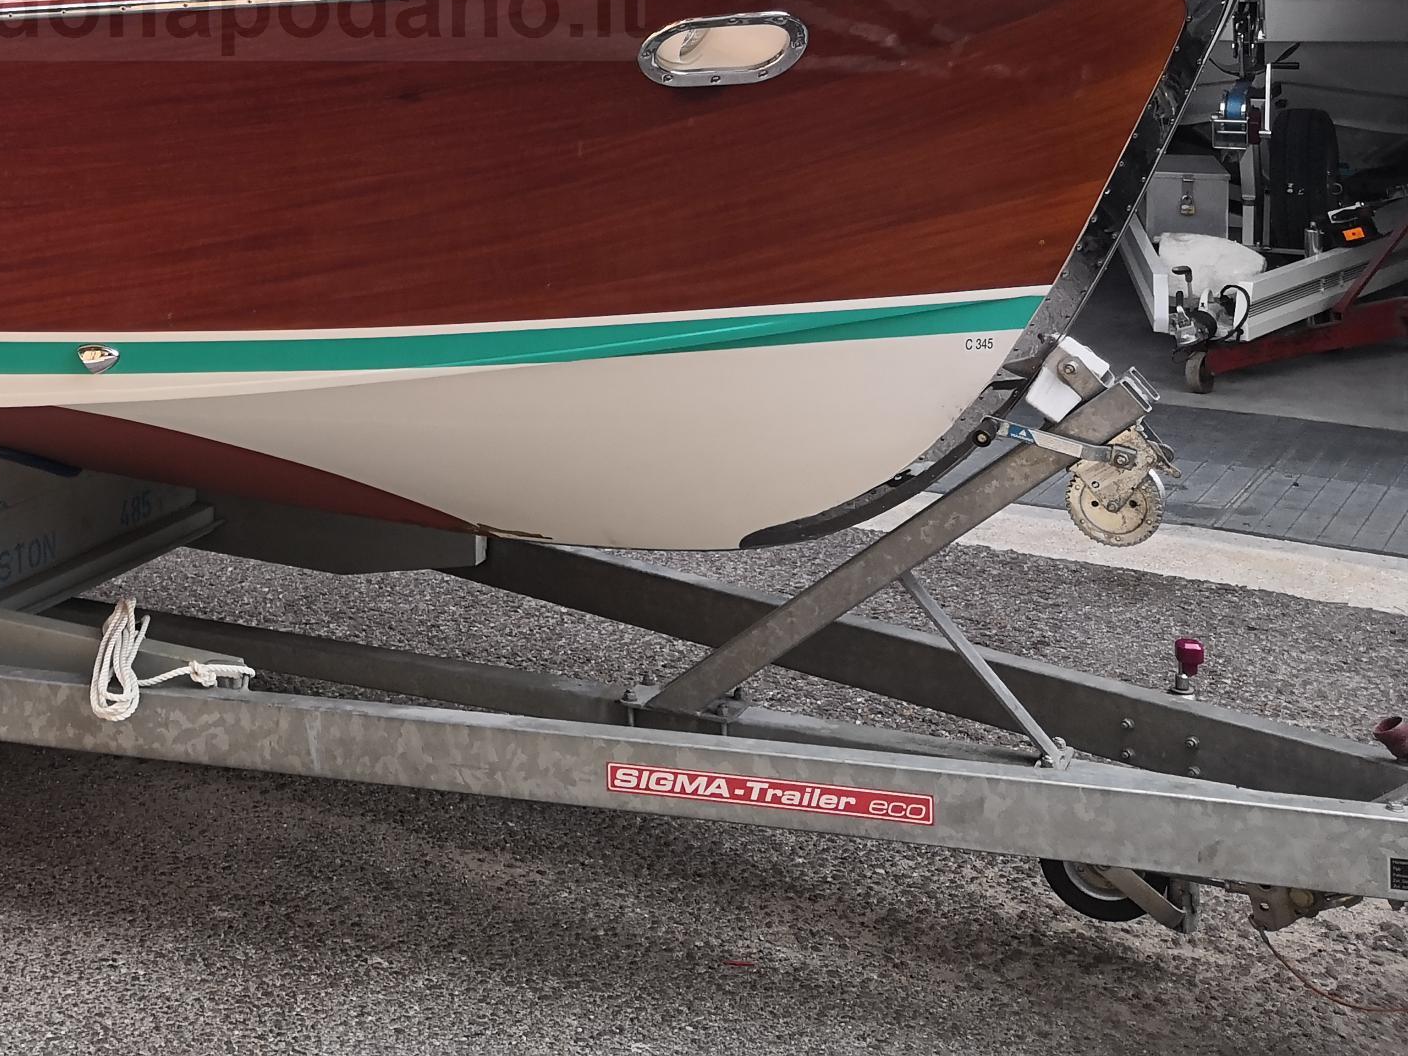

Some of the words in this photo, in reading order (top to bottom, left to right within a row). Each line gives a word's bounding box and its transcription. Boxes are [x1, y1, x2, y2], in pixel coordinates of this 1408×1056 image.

[965, 338, 973, 351] C
[975, 337, 994, 350] 345
[612, 766, 857, 811] SIGMA-Trailer
[867, 799, 928, 820] eco
